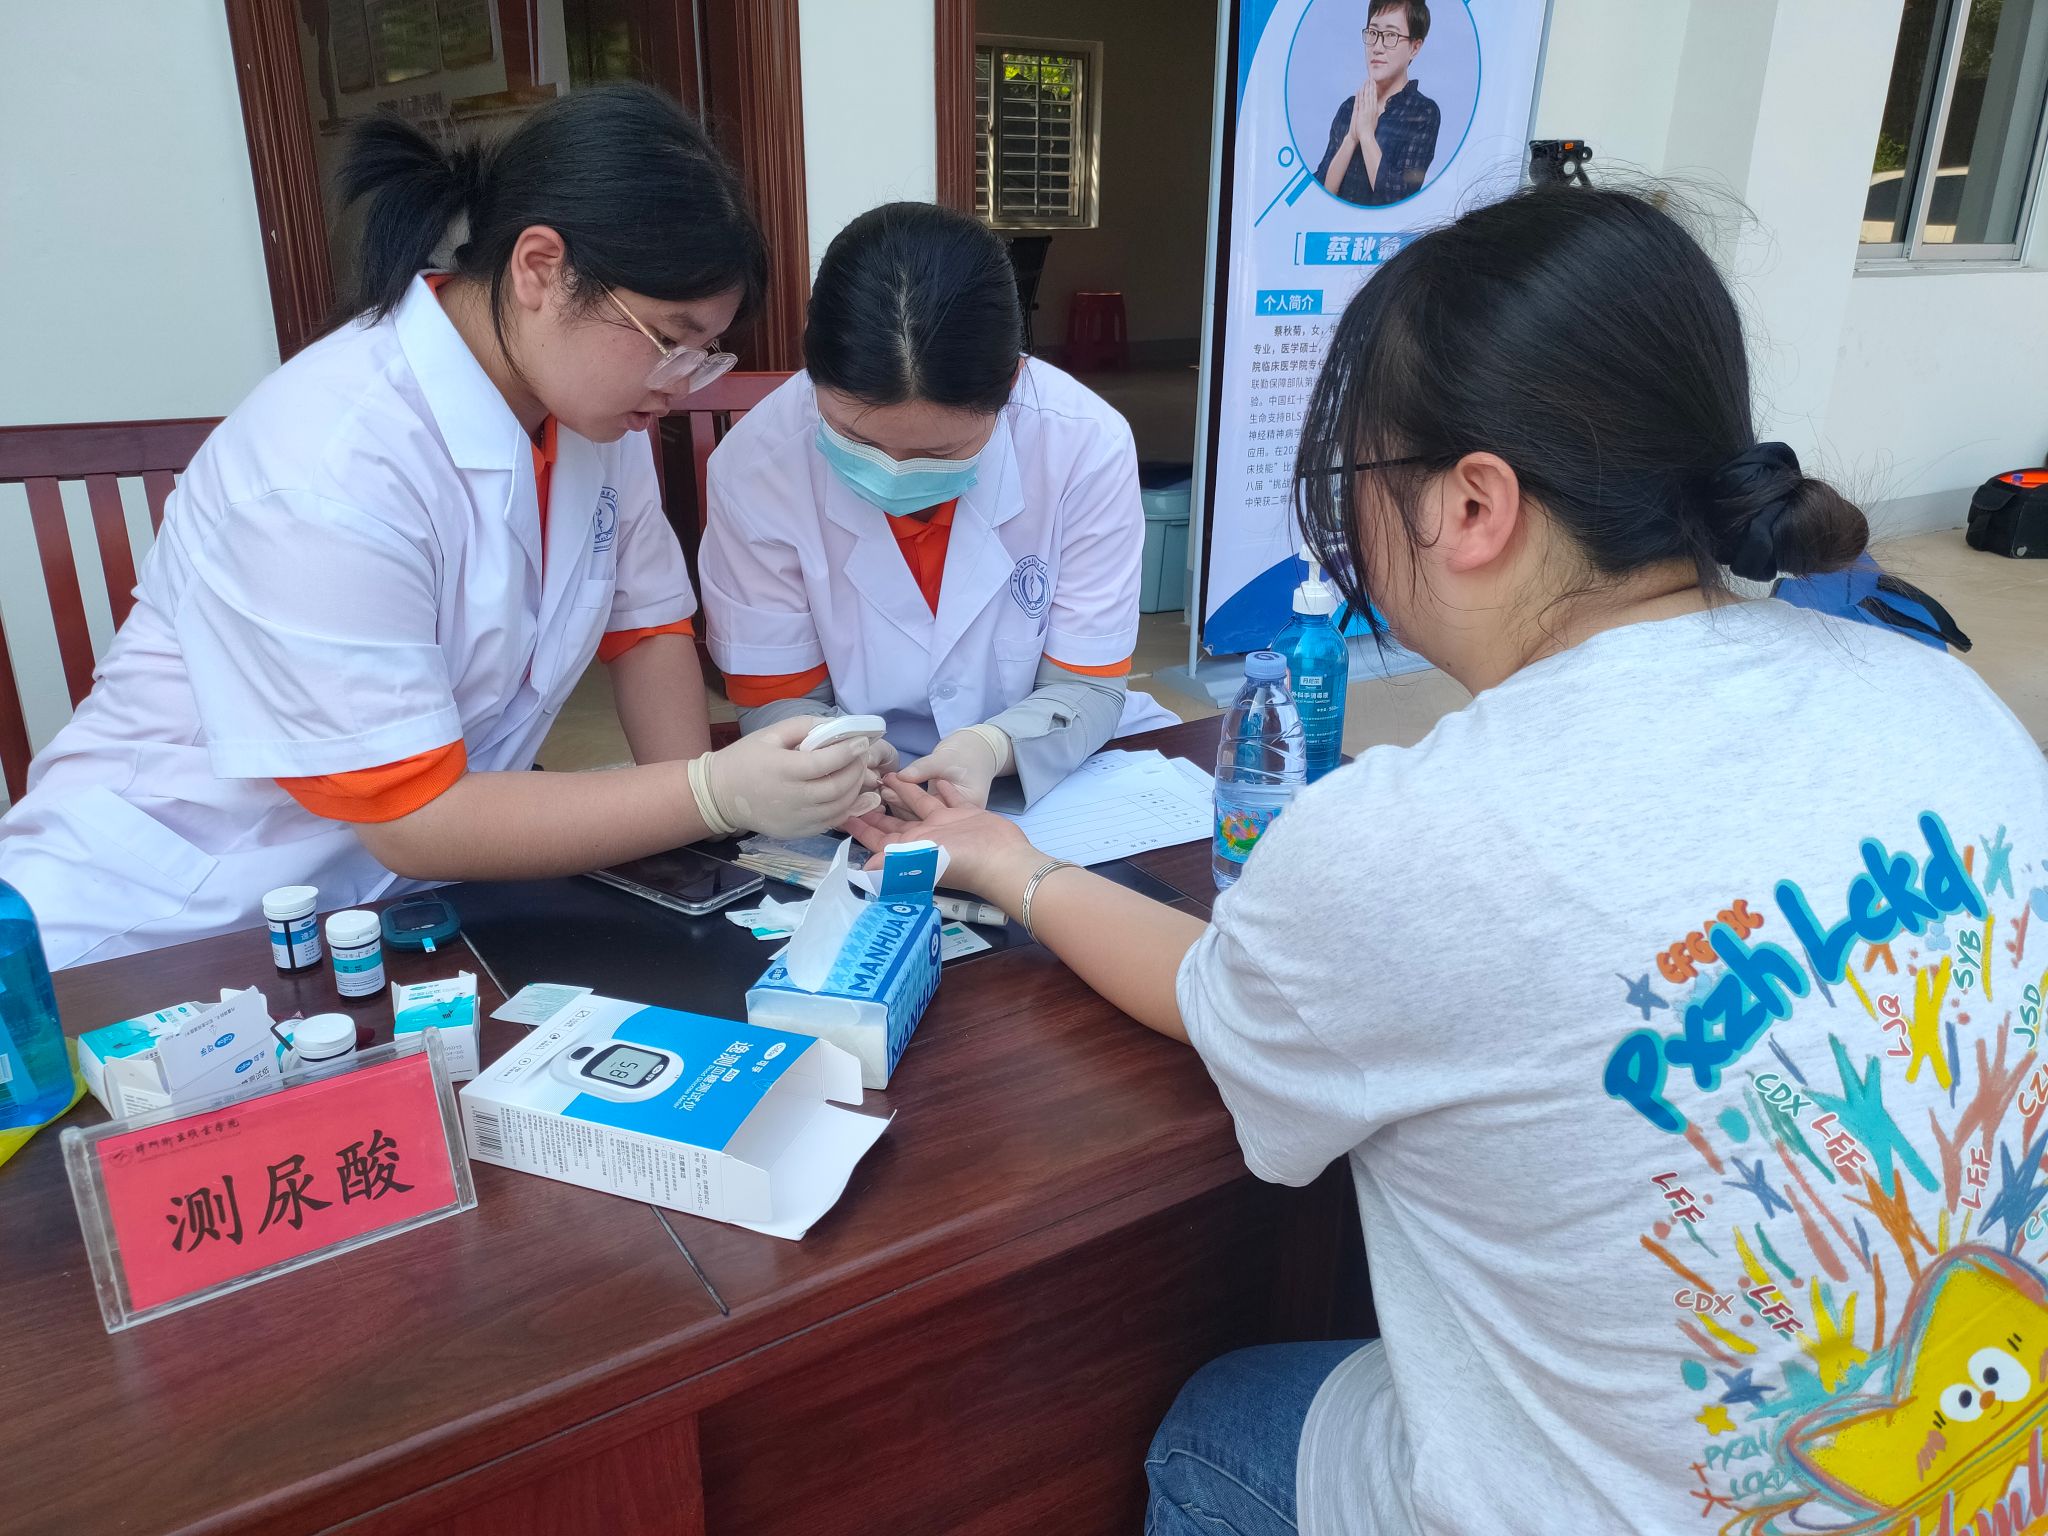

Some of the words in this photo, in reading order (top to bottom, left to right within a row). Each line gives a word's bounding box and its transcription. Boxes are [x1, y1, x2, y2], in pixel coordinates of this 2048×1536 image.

[1263, 294, 1314, 311] 个人简介
[1251, 377, 1318, 389] 联勤保障部队第
[1250, 412, 1304, 424] 生命支持BLS
[848, 918, 909, 992] MANHUA
[1950, 928, 1983, 991] SYB
[1876, 993, 1914, 1058] LJQ
[2012, 983, 2042, 1050] JSD
[1752, 1072, 1812, 1118] CDX
[1811, 1112, 1867, 1171] LFF
[166, 1129, 414, 1253] 测尿酸
[1649, 1171, 1706, 1225] LFF
[1958, 1147, 1993, 1210] LFF
[1673, 1288, 1734, 1316] CDX
[1747, 1284, 1804, 1336] LFF
